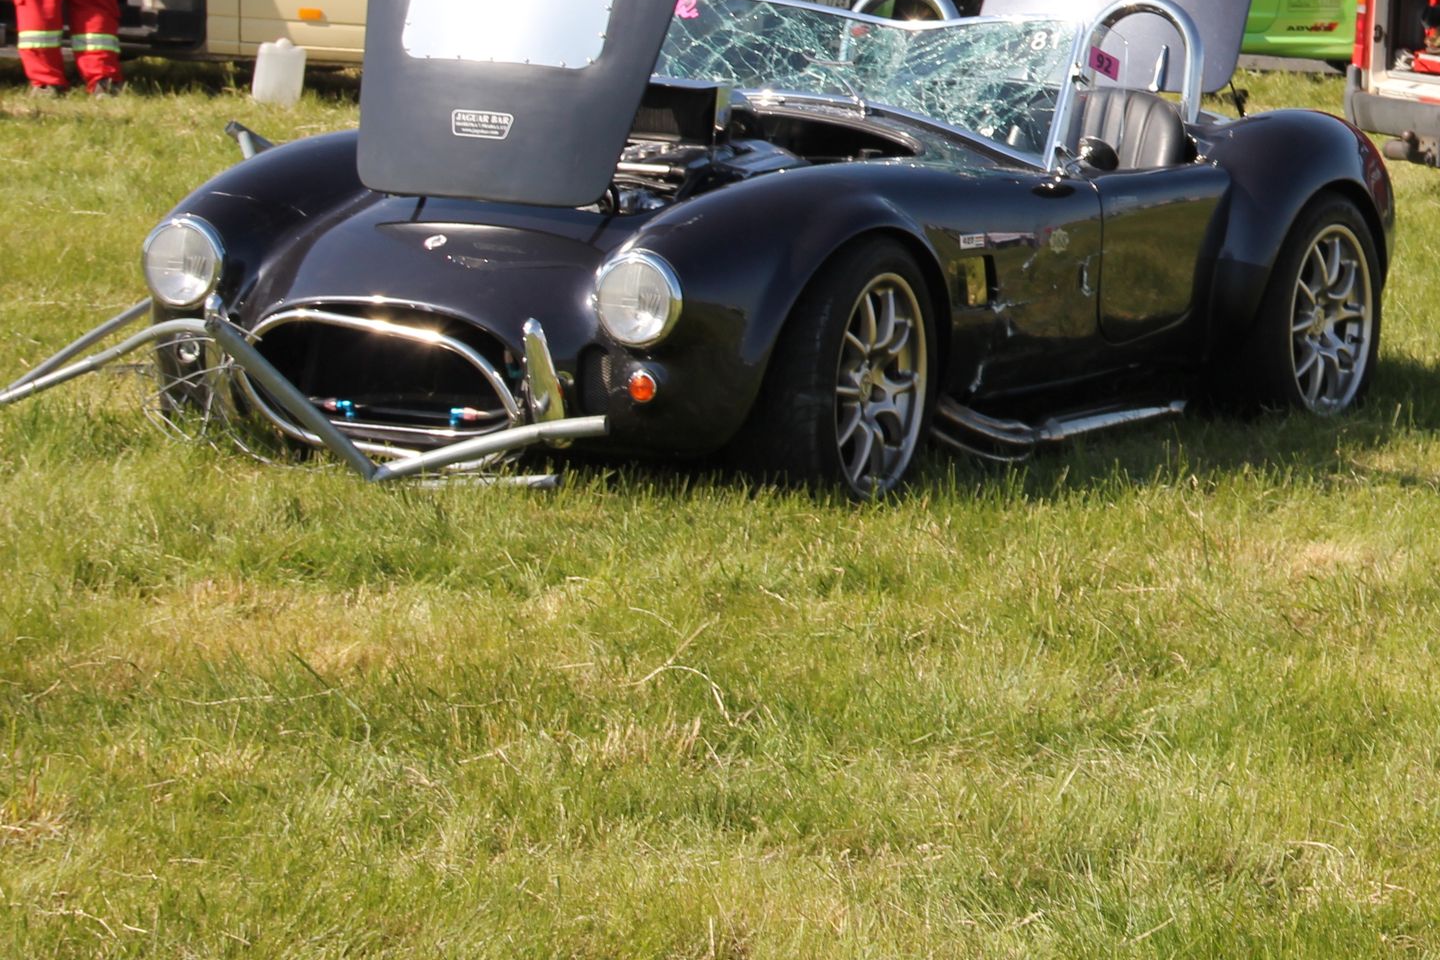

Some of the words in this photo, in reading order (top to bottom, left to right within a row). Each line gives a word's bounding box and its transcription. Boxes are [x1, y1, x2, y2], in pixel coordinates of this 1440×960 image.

[1031, 31, 1060, 50] 81
[1096, 54, 1112, 74] 92
[491, 115, 510, 124] BAR
